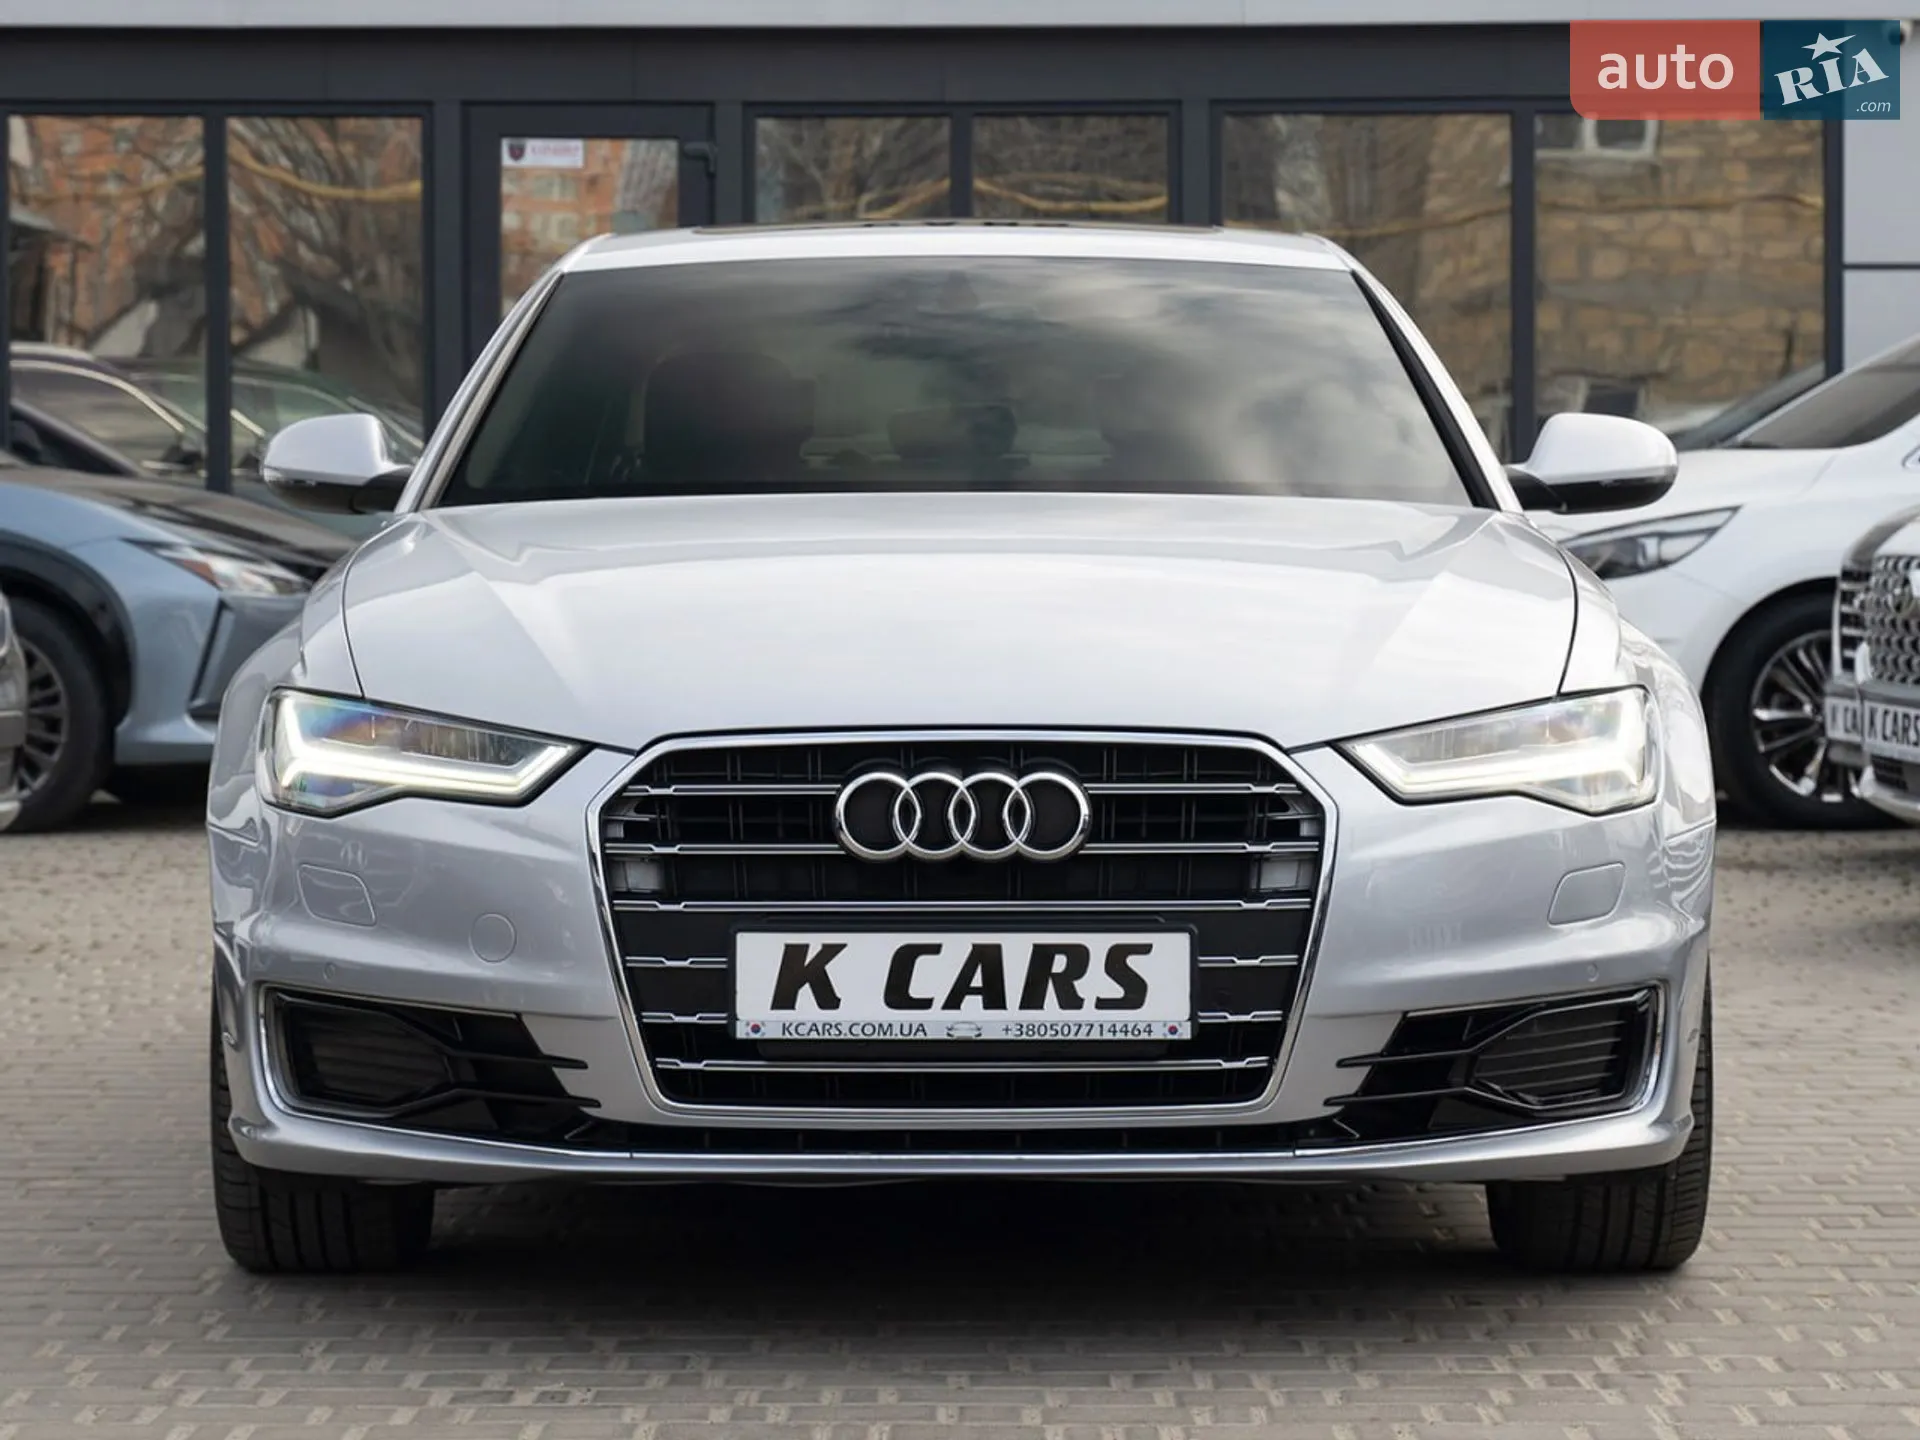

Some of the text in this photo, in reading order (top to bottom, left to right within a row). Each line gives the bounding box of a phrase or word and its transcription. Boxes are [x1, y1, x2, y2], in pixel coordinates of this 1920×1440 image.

[1867, 706, 1878, 739] K
[770, 943, 1153, 1011] K CARS
[781, 1022, 1153, 1037] KCARS.COM.UA +380507714464
